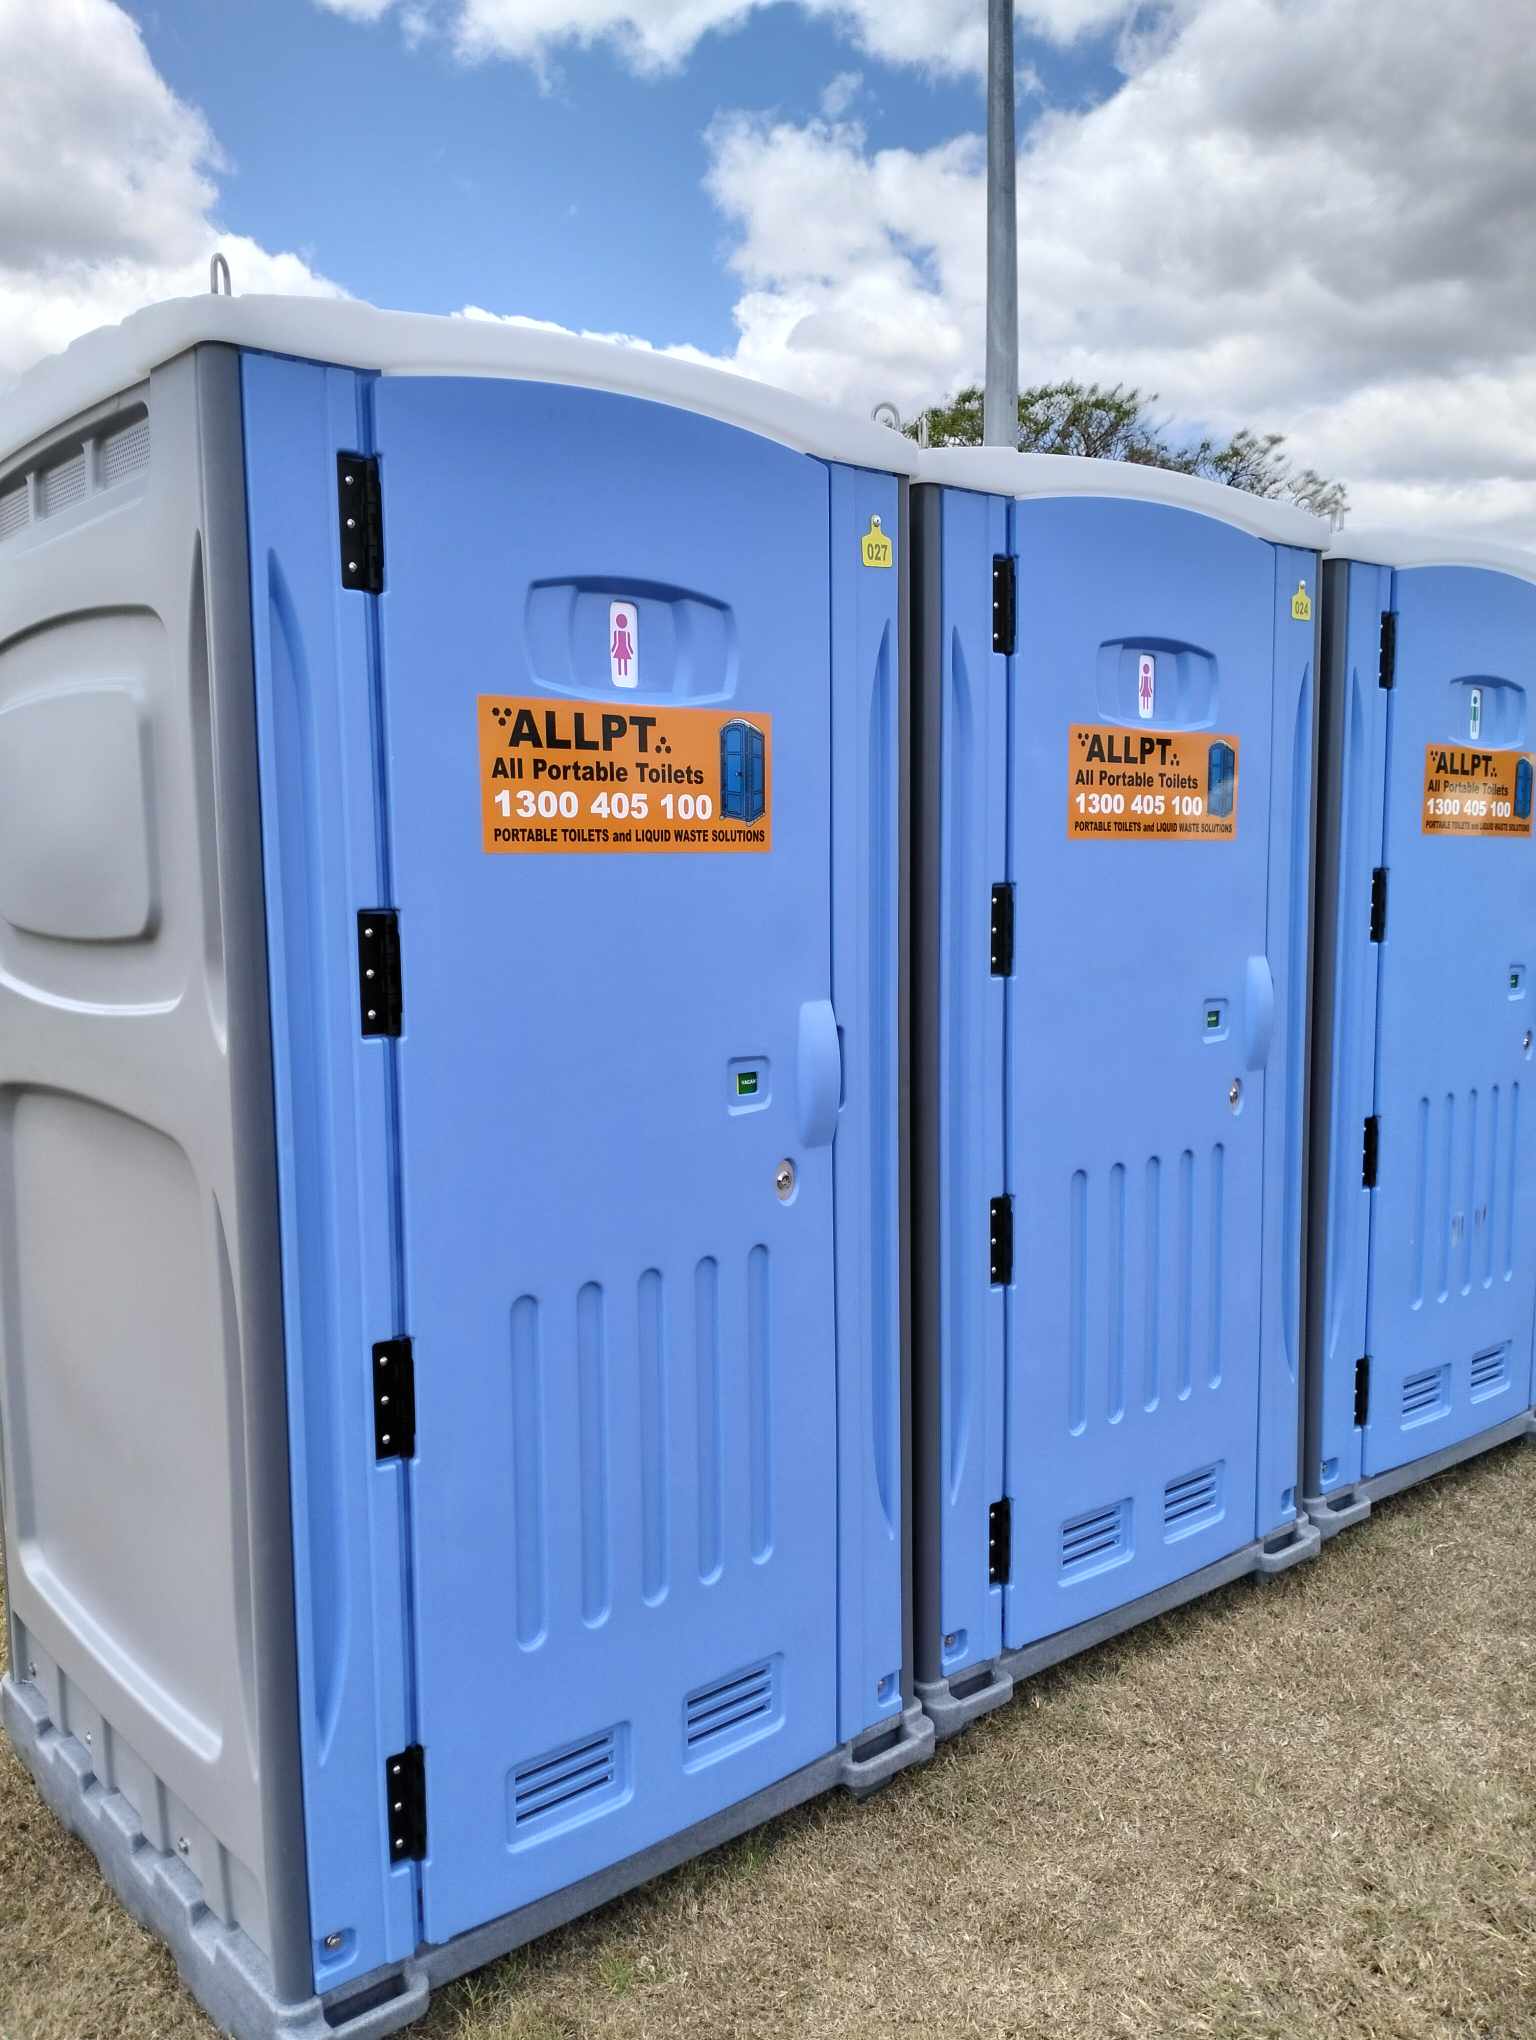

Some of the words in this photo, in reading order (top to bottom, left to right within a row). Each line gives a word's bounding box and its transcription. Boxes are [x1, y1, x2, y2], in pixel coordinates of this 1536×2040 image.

[867, 544, 888, 560] 027
[508, 709, 656, 752] ALLPT
[1086, 734, 1172, 765] ALLPT
[492, 757, 523, 779] All
[533, 759, 628, 782] Portable
[635, 763, 704, 785] Toilets
[1435, 752, 1492, 776] ALLPT
[1075, 770, 1093, 785] All
[1099, 771, 1154, 787] Portable
[1159, 773, 1198, 789] Toilets
[1428, 780, 1440, 792] All
[1444, 781, 1479, 793] Portable
[1482, 783, 1508, 796] Toilets
[494, 790, 578, 818] 1300
[591, 792, 648, 819] 405
[660, 794, 712, 820] 100
[1076, 793, 1124, 814] 1300
[1131, 795, 1164, 814] 405
[1171, 796, 1202, 815] 100
[1427, 798, 1459, 815] 1300
[1464, 800, 1486, 816] 405
[1490, 802, 1510, 817] 100
[494, 828, 558, 841] PORTABLE
[561, 829, 609, 842] TOILETS
[613, 830, 631, 842] and
[635, 829, 671, 843] LIQUID
[674, 830, 708, 842] WASTE
[712, 830, 765, 842] SOLUTIONS
[1075, 821, 1111, 831] PORTABLE
[1114, 822, 1141, 832] TOILETS
[1143, 823, 1154, 832] and
[1156, 823, 1177, 832] LIQUID
[1179, 823, 1199, 832] WASTE
